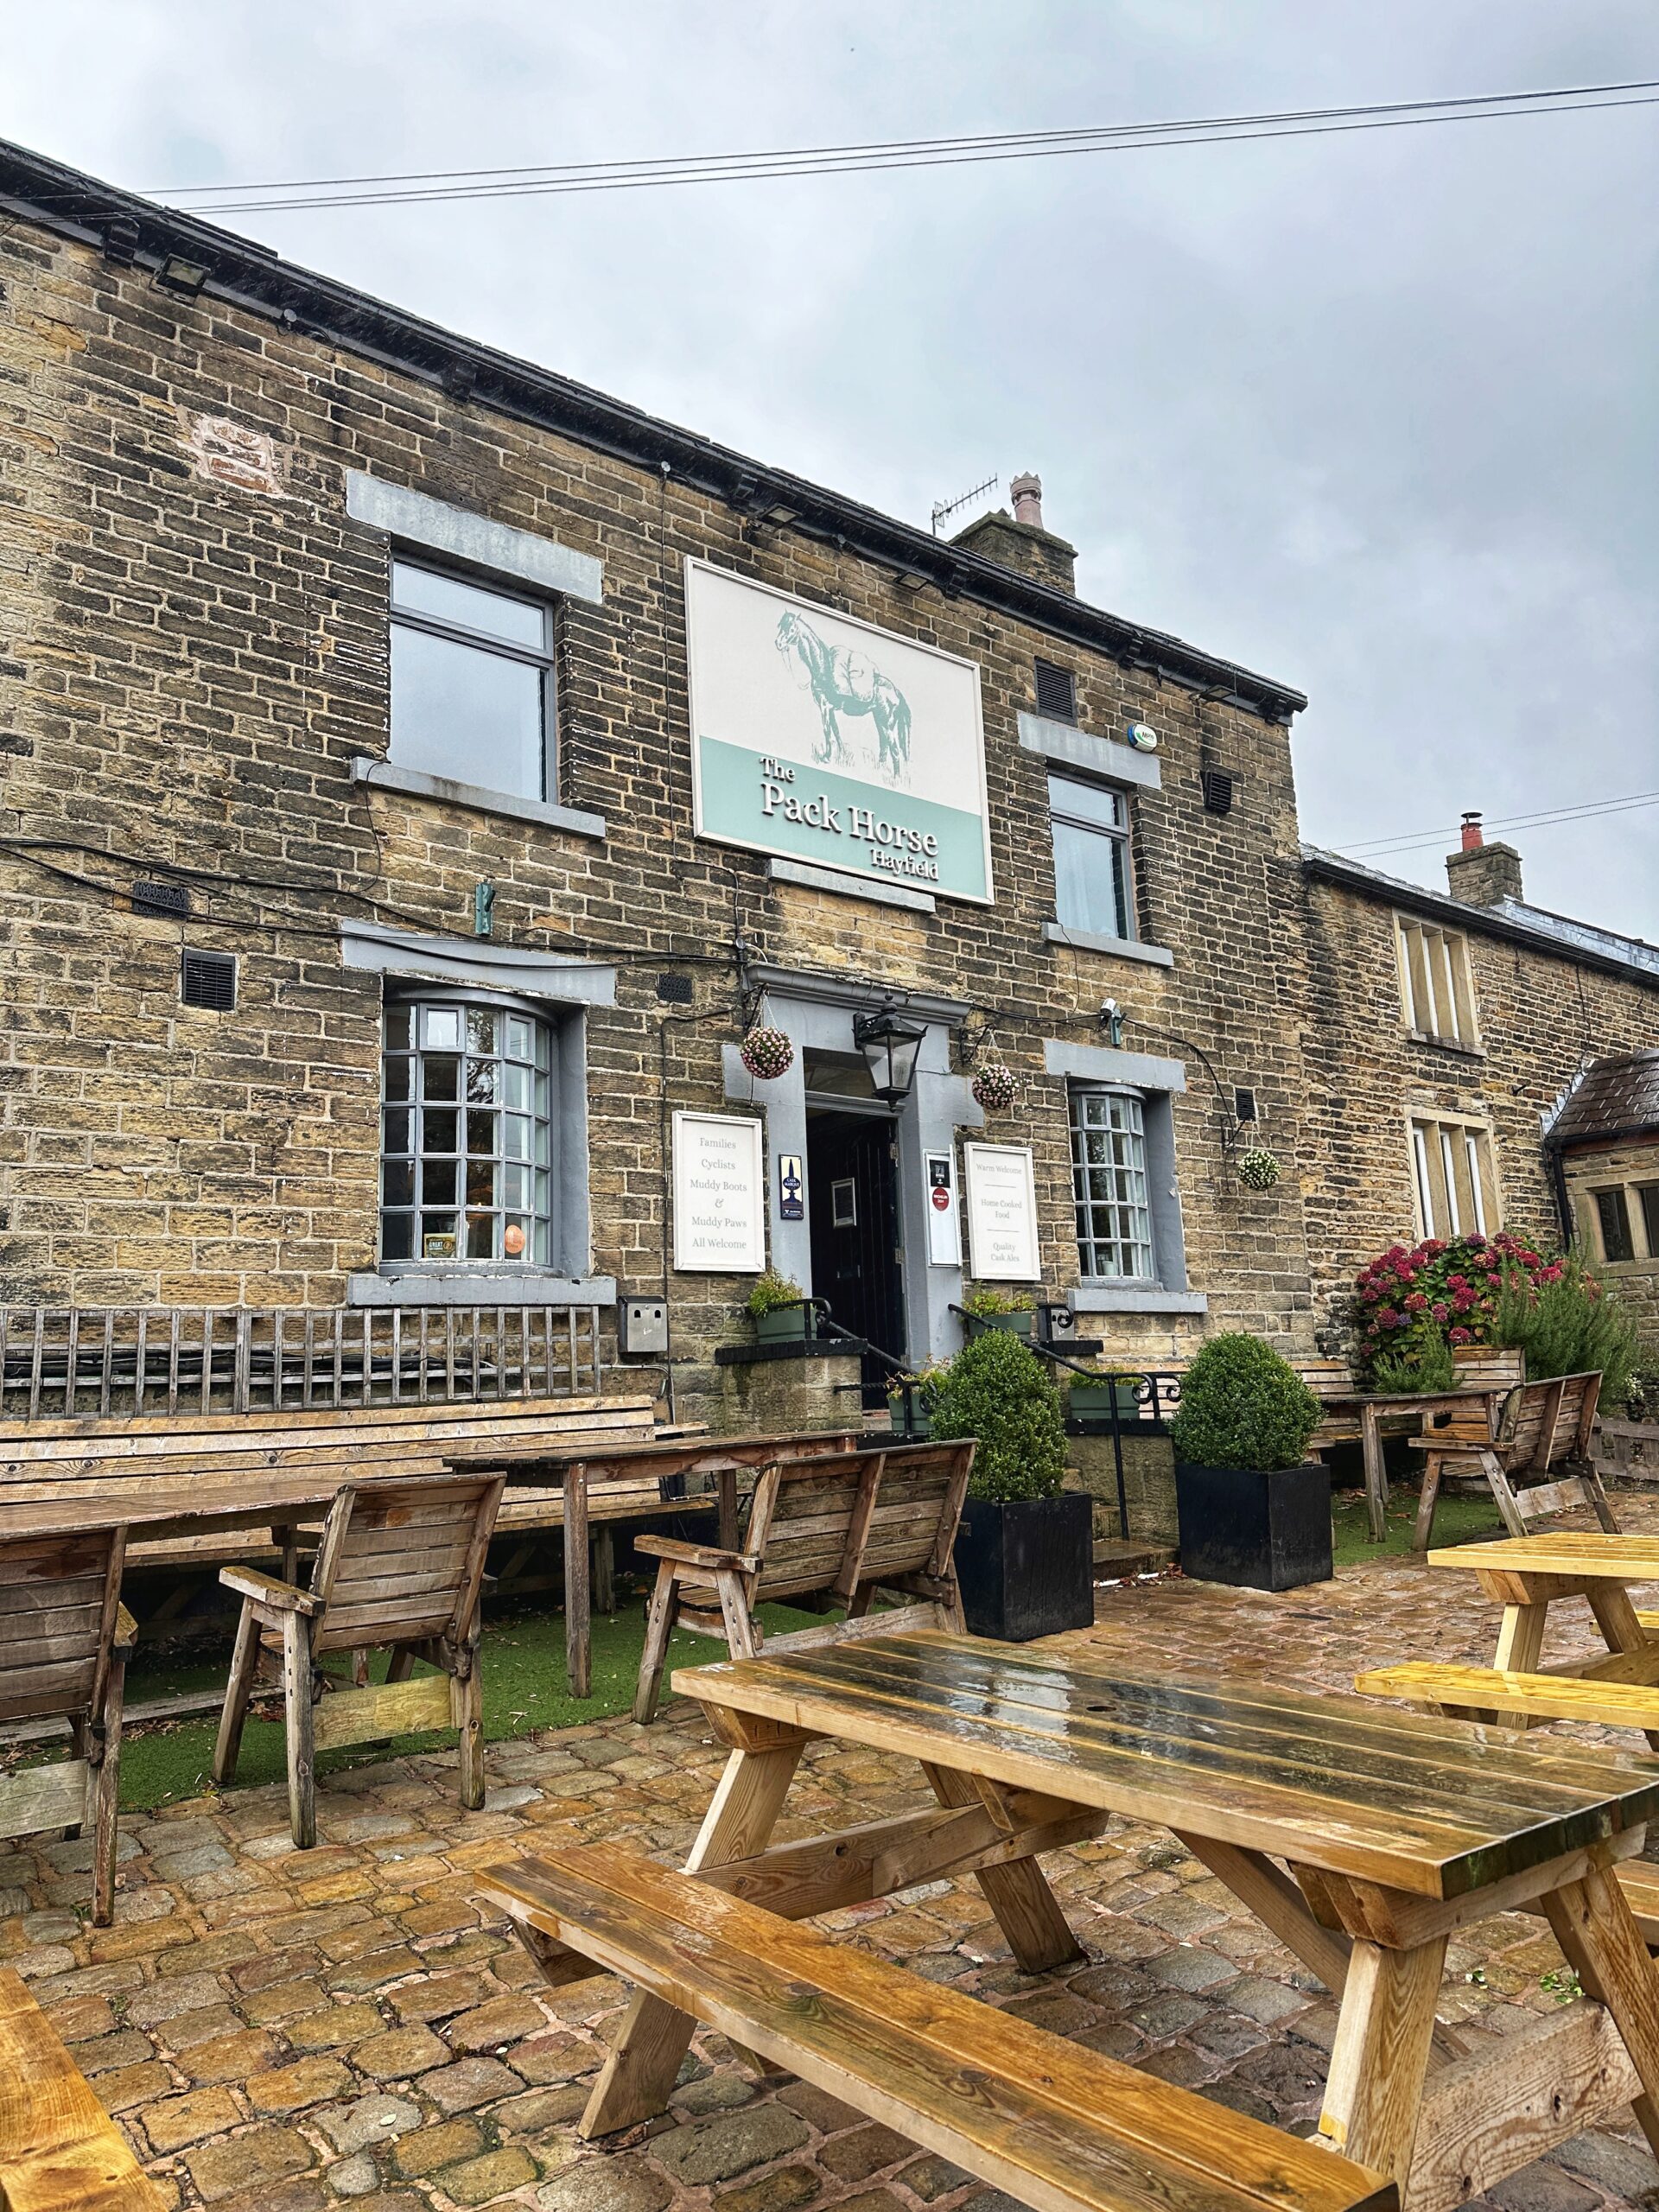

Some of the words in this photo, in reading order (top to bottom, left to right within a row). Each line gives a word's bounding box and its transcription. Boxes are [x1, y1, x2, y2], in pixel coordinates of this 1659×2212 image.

[760, 757, 796, 783] The
[760, 782, 842, 834] Pack
[848, 805, 938, 857] Horse
[870, 848, 939, 881] Hayfield
[700, 1137, 736, 1149] Families
[701, 1158, 735, 1171] Cyclists
[976, 1163, 995, 1173] Warm
[995, 1165, 1022, 1174] Welcome
[690, 1179, 721, 1192] Muddy
[723, 1181, 747, 1192] Boots
[715, 1198, 724, 1208] &
[981, 1198, 999, 1207] Home
[1000, 1200, 1022, 1209] Cooked
[995, 1211, 1010, 1219] Food
[691, 1216, 722, 1229] Muddy
[725, 1217, 747, 1228] Paws
[692, 1236, 705, 1248] All
[707, 1238, 747, 1249] Welcome
[993, 1243, 1016, 1252] Quality
